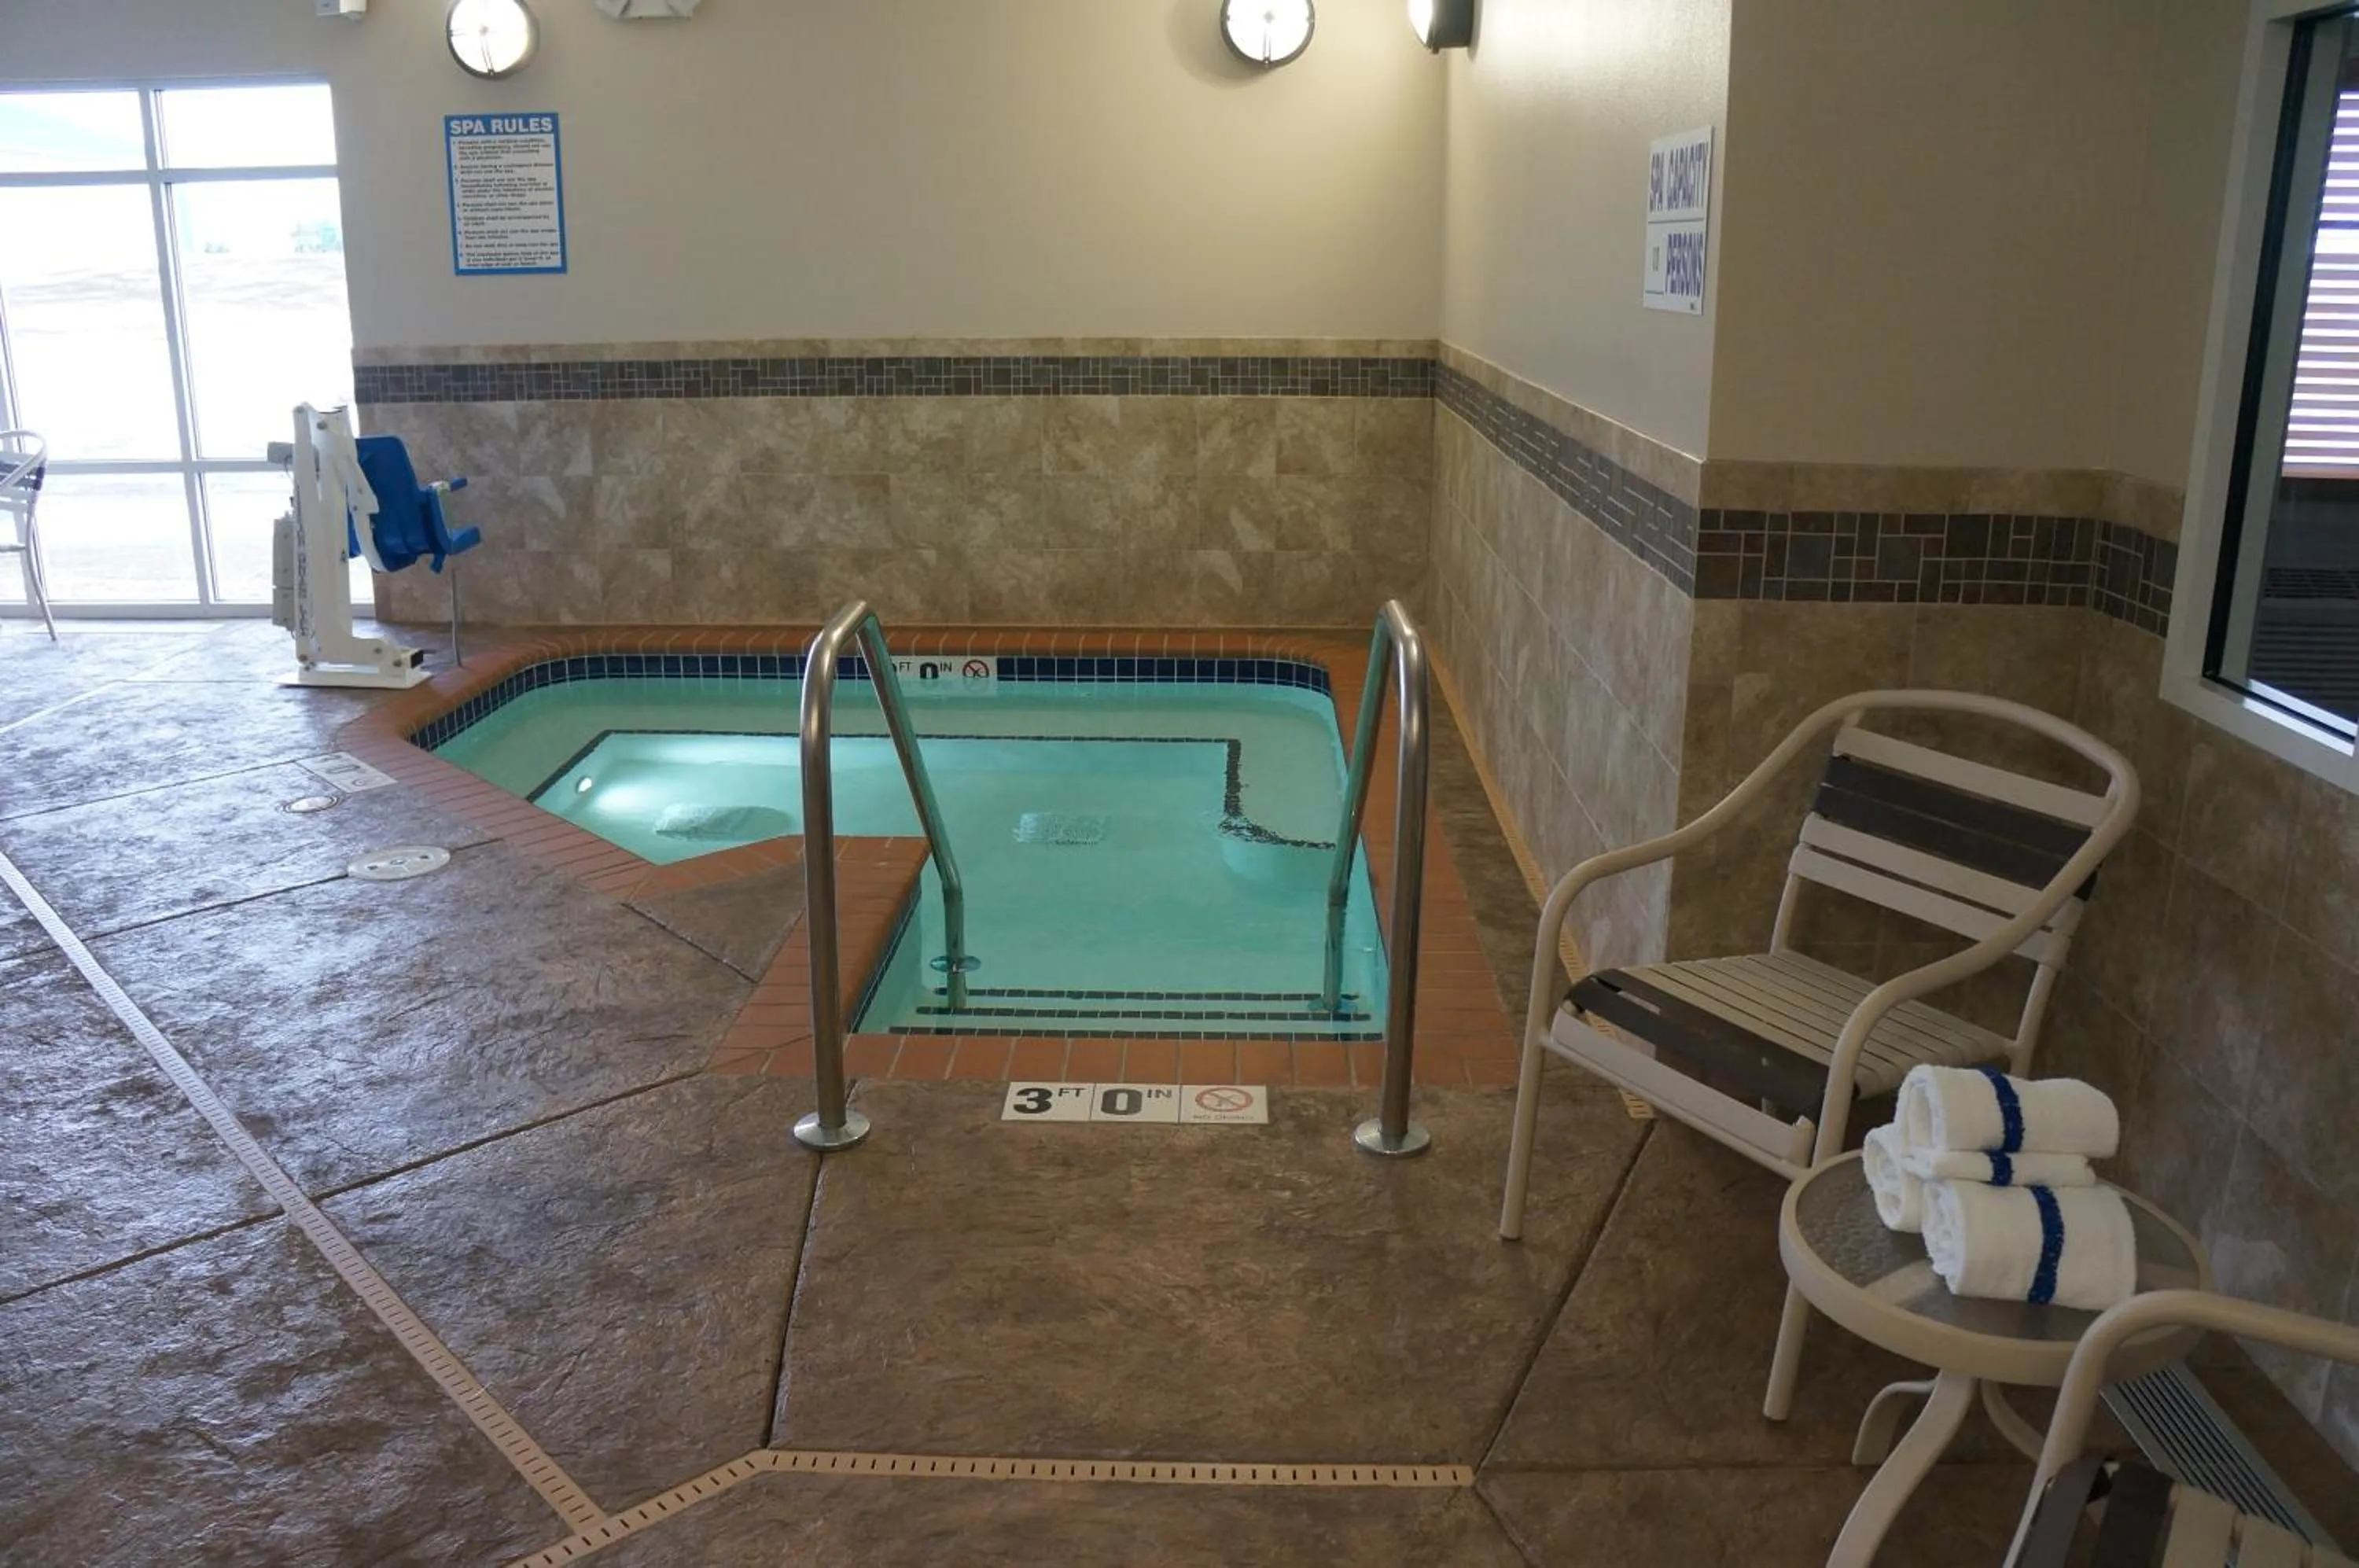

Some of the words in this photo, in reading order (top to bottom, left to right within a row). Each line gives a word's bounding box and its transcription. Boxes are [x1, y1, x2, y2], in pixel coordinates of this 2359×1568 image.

[451, 120, 485, 134] SPA
[491, 117, 553, 133] RULES
[1649, 152, 1665, 213] SPA
[1668, 142, 1709, 210] CAPACITY
[1665, 232, 1703, 296] PERSONS
[900, 662, 912, 671] FT
[940, 661, 952, 672] IN
[1013, 1088, 1053, 1114] 3
[1057, 1087, 1090, 1099] FT
[1099, 1088, 1143, 1117] 0
[1146, 1088, 1174, 1099] IN
